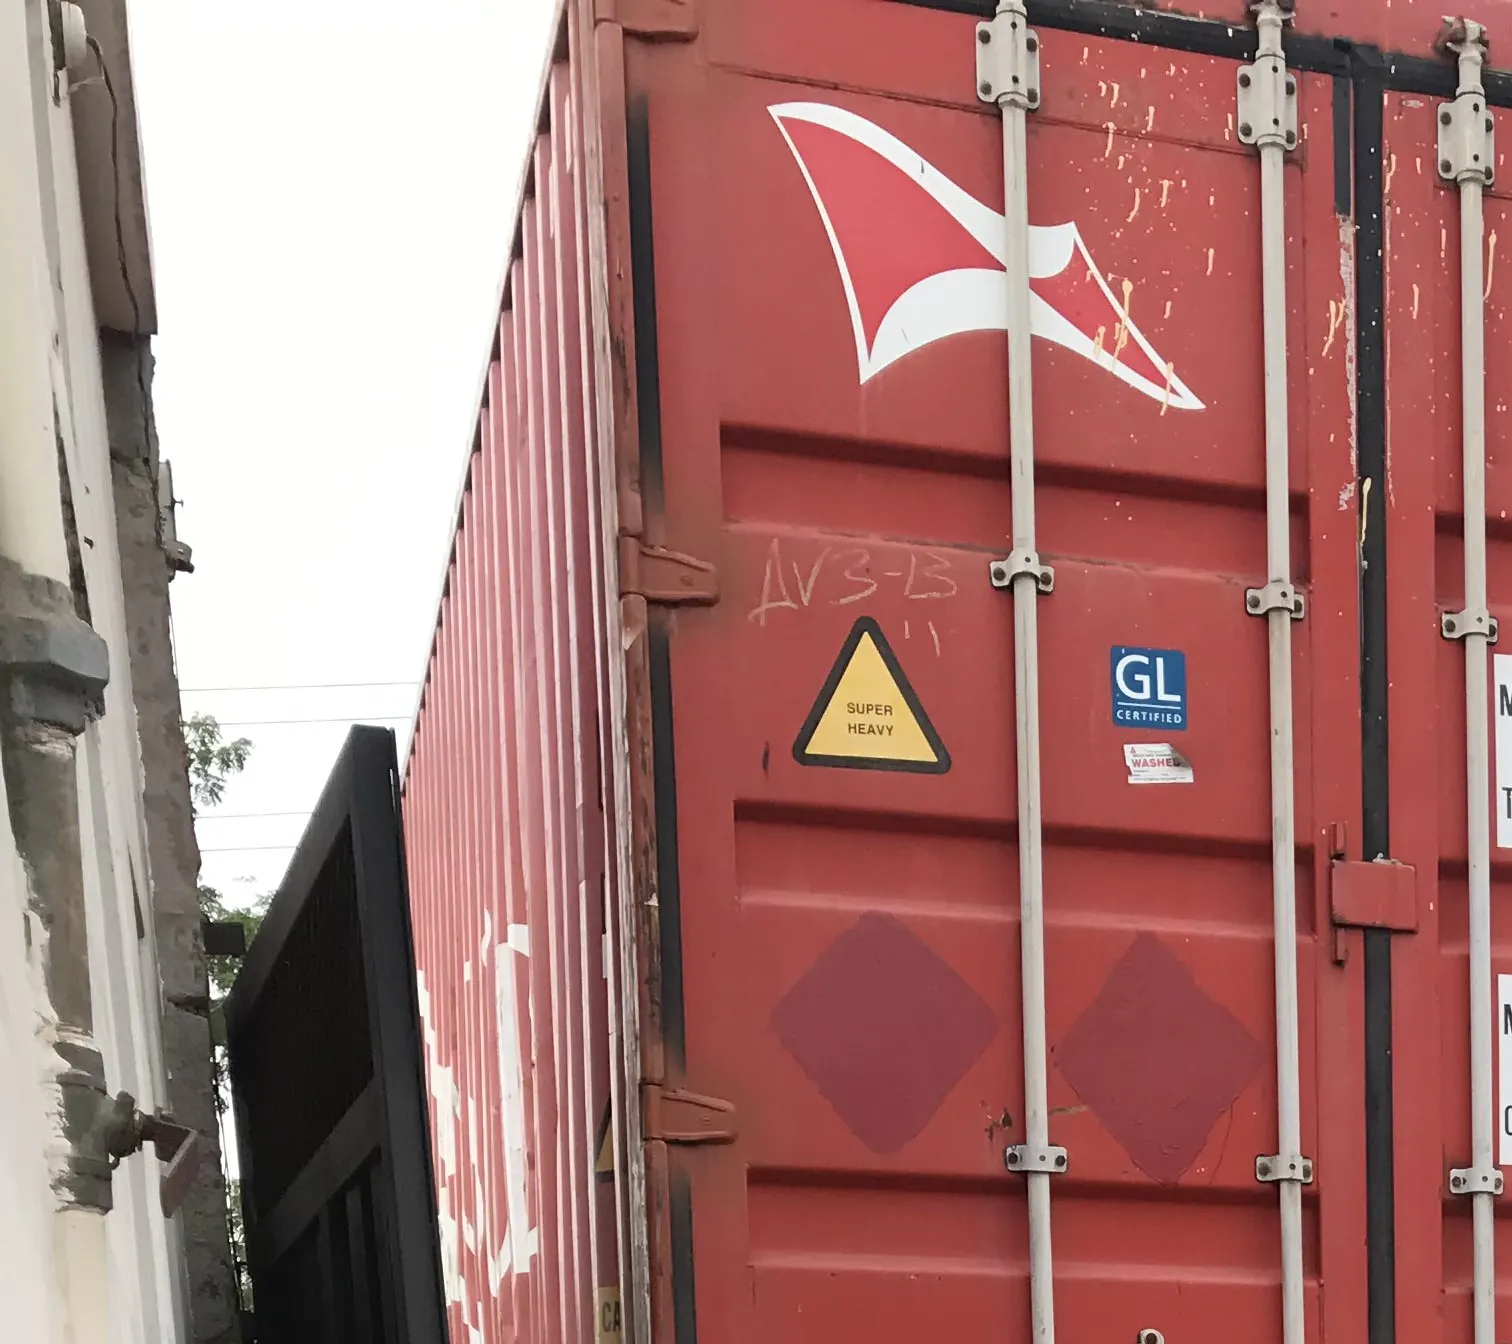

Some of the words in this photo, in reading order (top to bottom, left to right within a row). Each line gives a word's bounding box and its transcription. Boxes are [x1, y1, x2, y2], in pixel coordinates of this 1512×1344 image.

[1115, 654, 1182, 702] GL
[846, 701, 894, 717] SUPER
[1116, 709, 1183, 724] CERTIFIED
[847, 722, 895, 737] HEAVY
